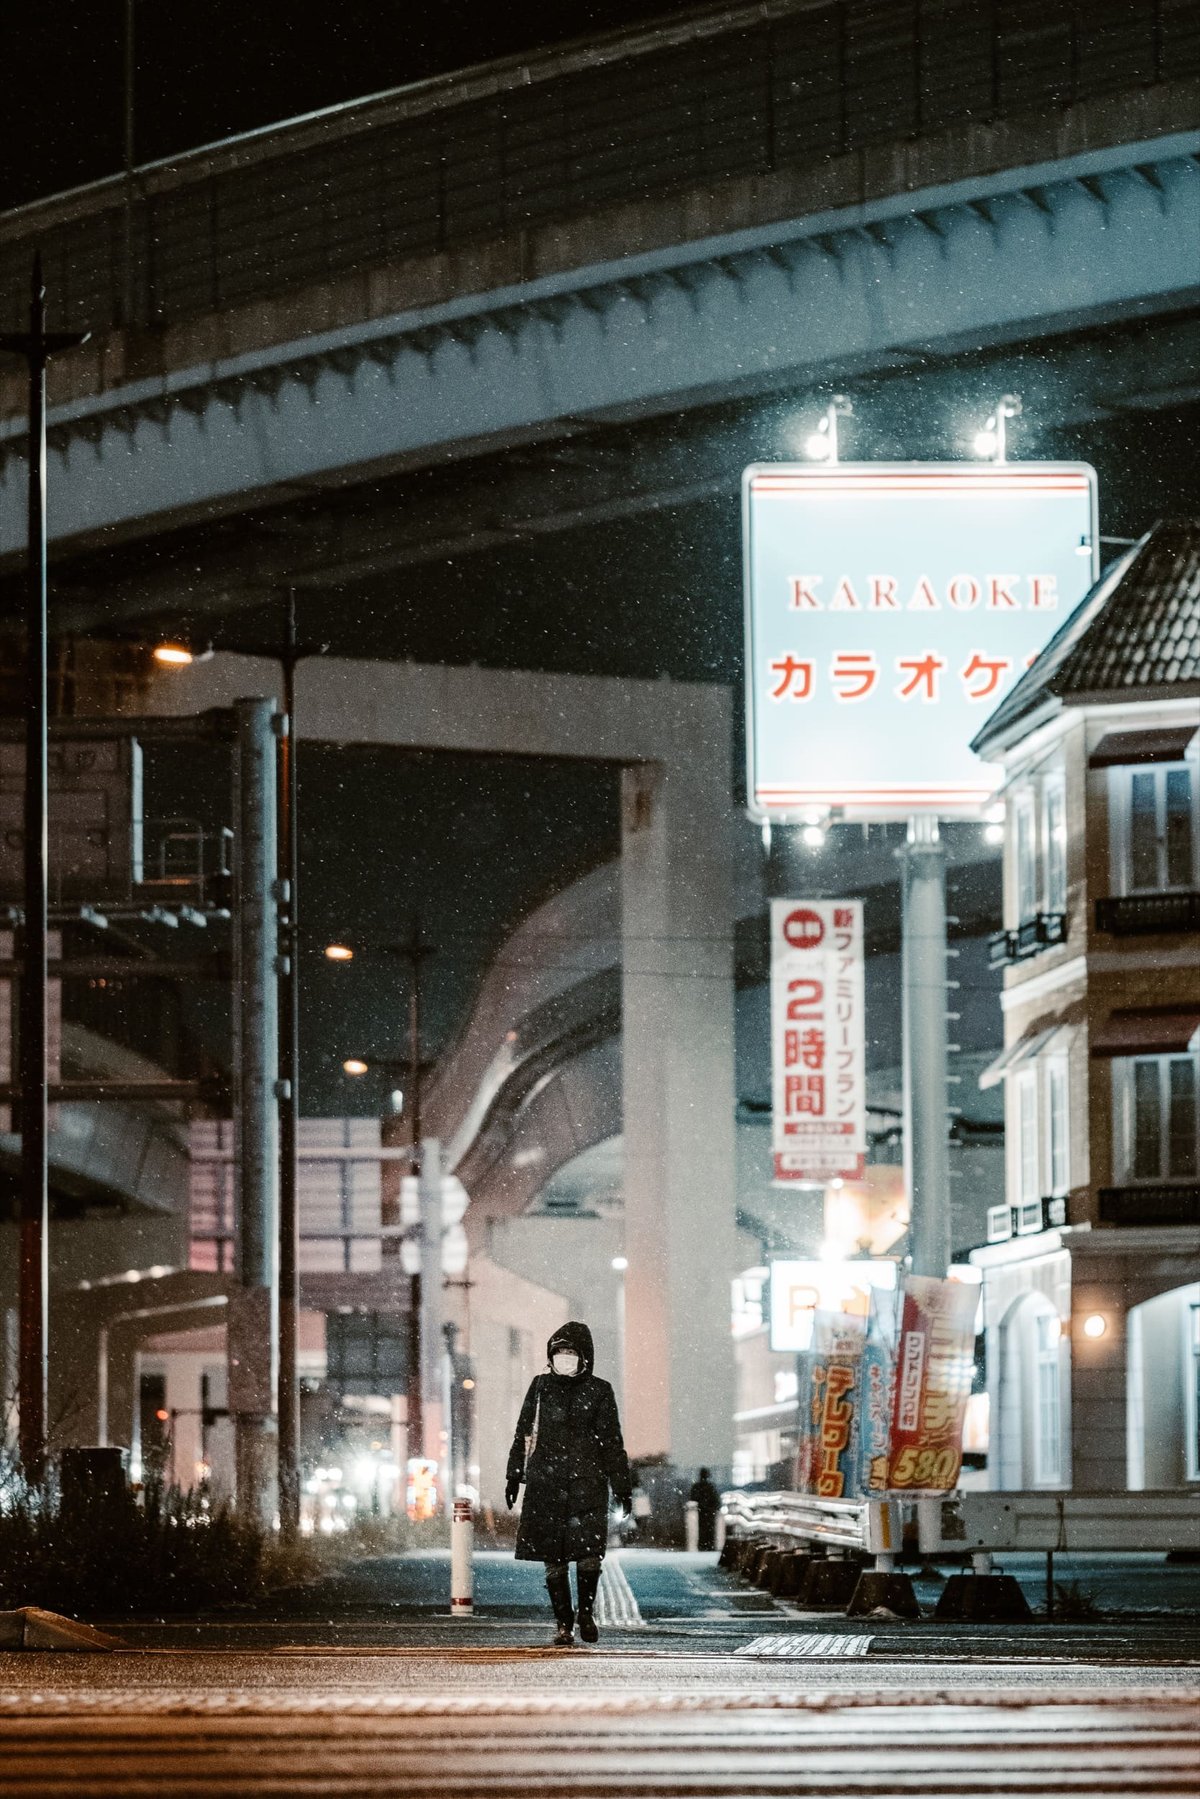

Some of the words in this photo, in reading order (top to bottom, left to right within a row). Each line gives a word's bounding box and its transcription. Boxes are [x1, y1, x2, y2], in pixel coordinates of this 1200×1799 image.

[789, 576, 1058, 610] KARAOKE
[769, 654, 1041, 699] カラオケ
[784, 978, 826, 1117] 2時間
[789, 1285, 820, 1328] P
[893, 1448, 955, 1482] 580
